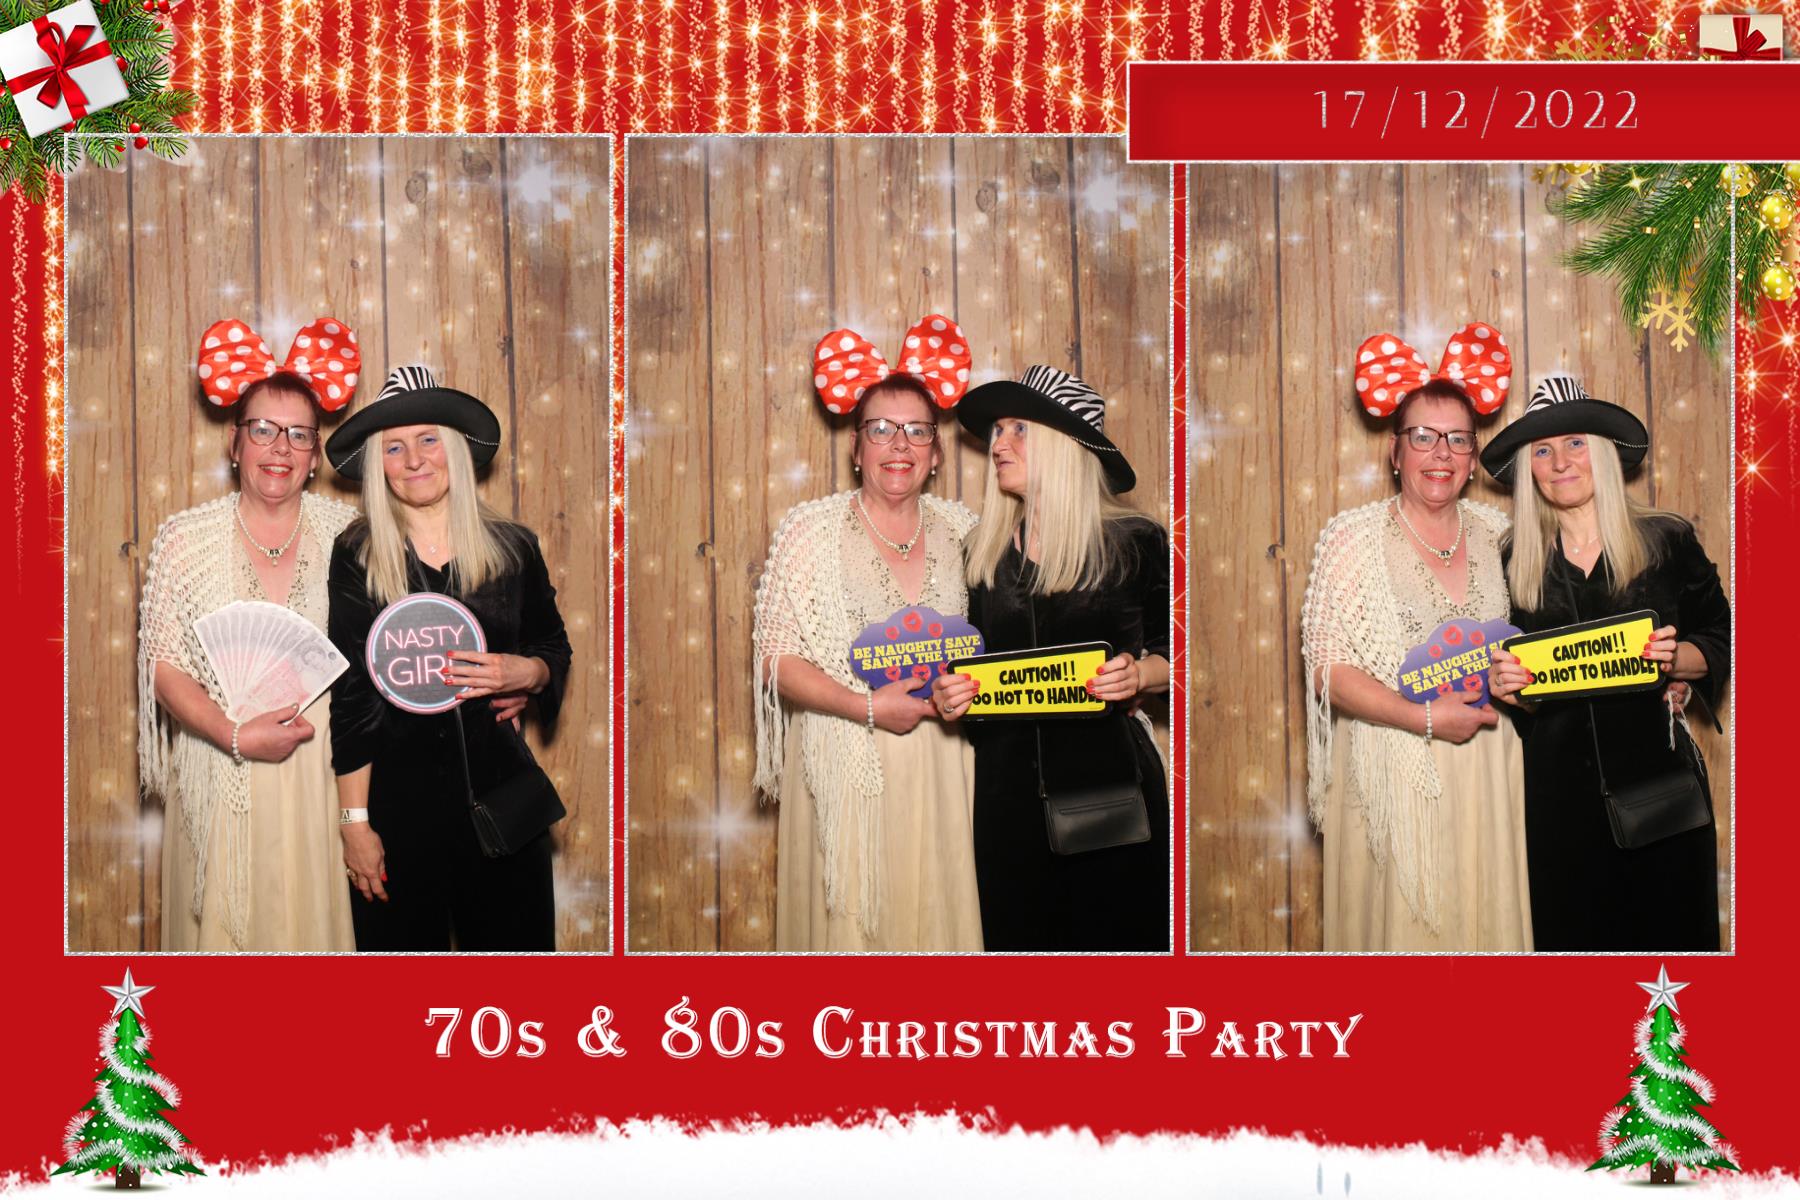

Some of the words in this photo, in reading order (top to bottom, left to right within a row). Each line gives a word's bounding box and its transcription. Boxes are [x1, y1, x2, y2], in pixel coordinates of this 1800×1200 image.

[384, 624, 465, 650] NASTY
[853, 647, 872, 660] BE
[873, 639, 942, 657] NAUGHTY
[944, 634, 981, 650] SAVE
[1552, 631, 1628, 662] CAUTION!!
[861, 655, 913, 671] SANTA
[915, 651, 943, 664] THE
[944, 646, 976, 661] TRIP
[1401, 670, 1422, 686] BE
[1420, 645, 1488, 678] NAUGHTY
[998, 660, 1077, 685] CAUTION!!
[1412, 670, 1463, 695] SANTA
[1463, 657, 1491, 675] THE
[1551, 667, 1577, 685] HOT
[1579, 663, 1599, 680] TO
[994, 689, 1023, 706] HOT
[1024, 688, 1045, 705] TO
